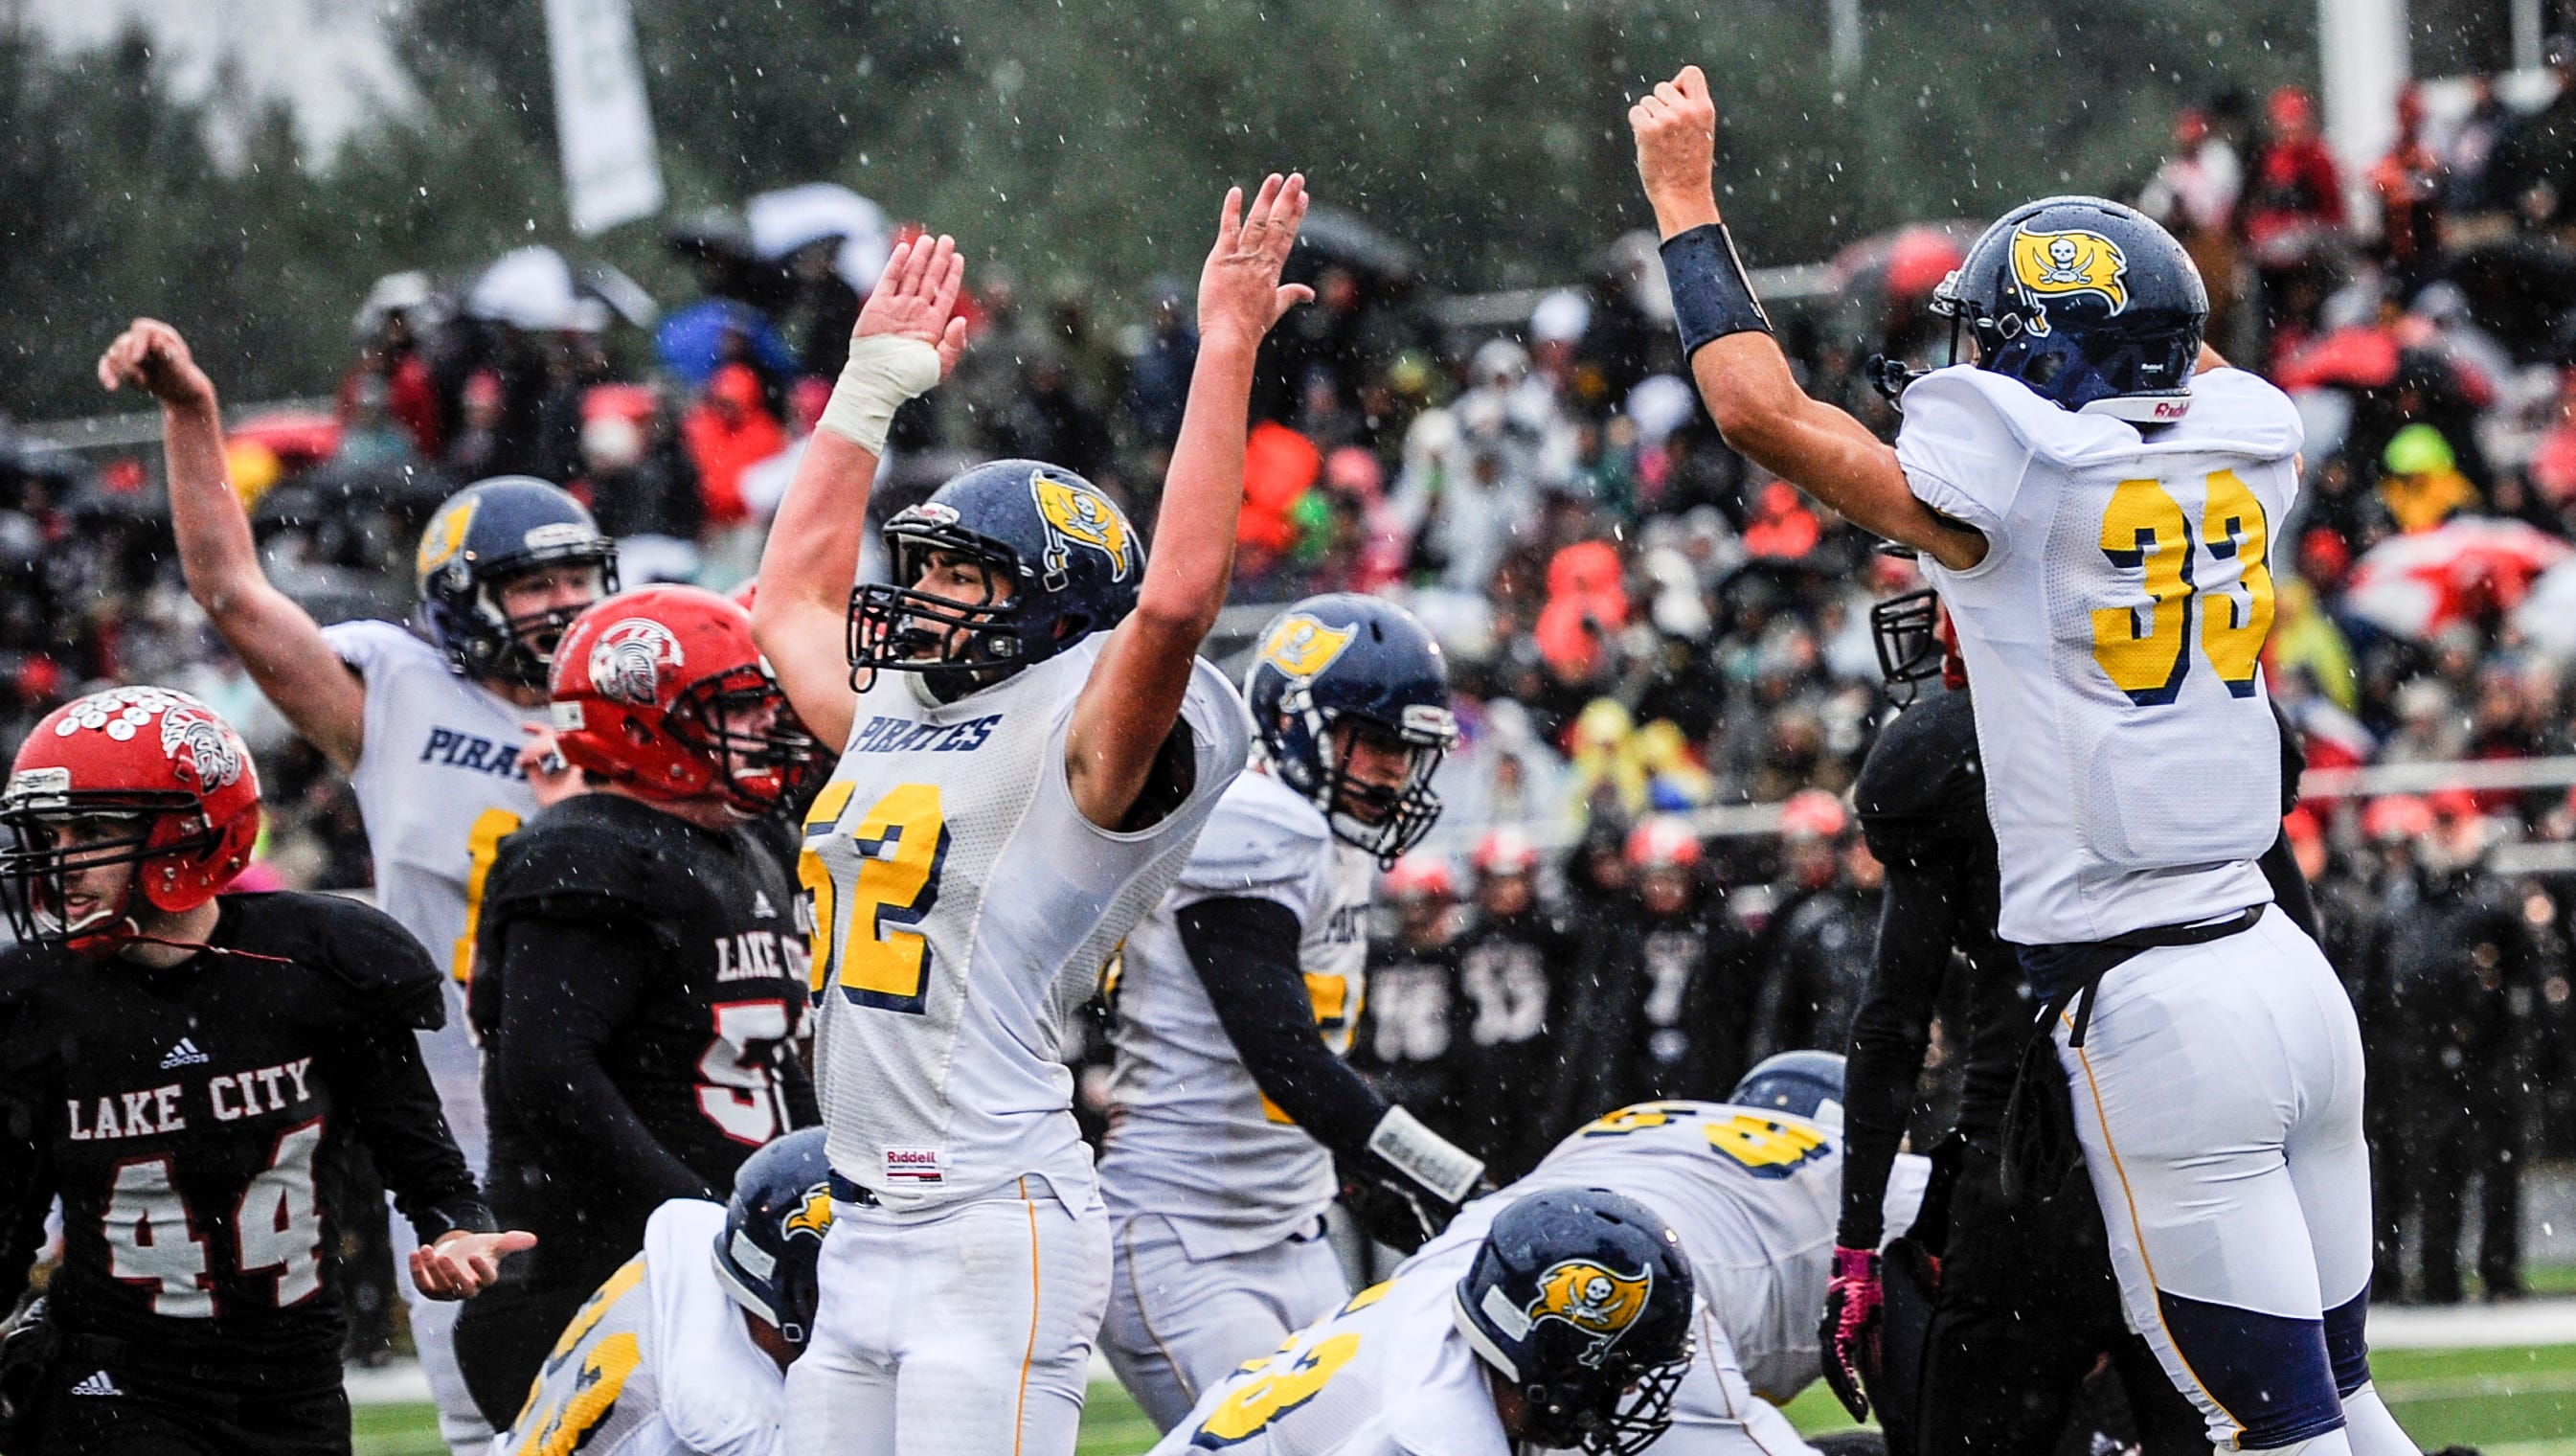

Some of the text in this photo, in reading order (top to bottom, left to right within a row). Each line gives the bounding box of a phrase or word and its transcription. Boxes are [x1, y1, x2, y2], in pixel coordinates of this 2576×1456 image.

[2090, 469, 2276, 708] 33
[849, 714, 1005, 753] PIRATES
[797, 780, 952, 1016] 52
[67, 1057, 313, 1141] LAKE CITY
[693, 998, 812, 1148] 5
[101, 1115, 325, 1319] 44
[887, 1151, 937, 1164] Riddell
